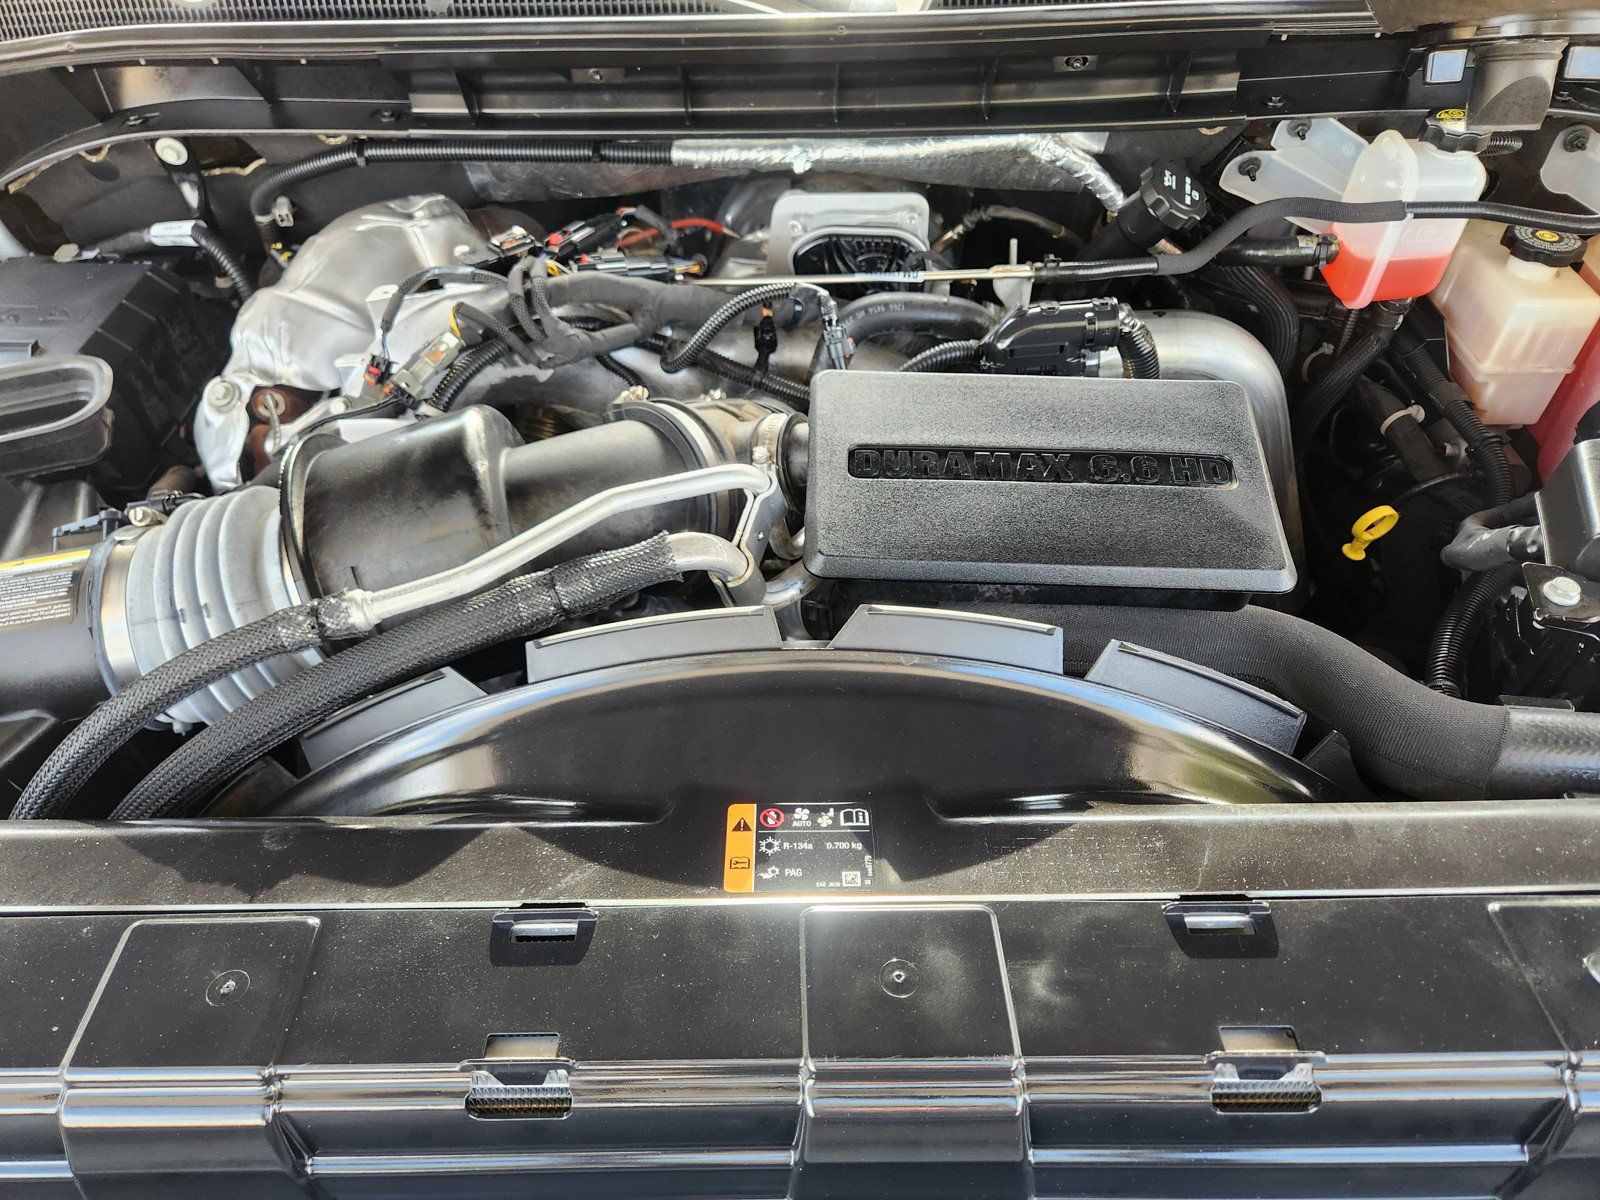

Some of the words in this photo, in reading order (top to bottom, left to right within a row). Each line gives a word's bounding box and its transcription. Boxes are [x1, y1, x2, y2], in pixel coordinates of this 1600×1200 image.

[854, 450, 1075, 482] DURAMAX
[1089, 454, 1160, 483] 6.6
[1169, 456, 1231, 485] HD
[792, 820, 812, 828] AUTO
[783, 842, 814, 850] R-134a
[826, 841, 850, 850] 0.700
[851, 841, 863, 850] kg
[784, 868, 803, 877] PAG
